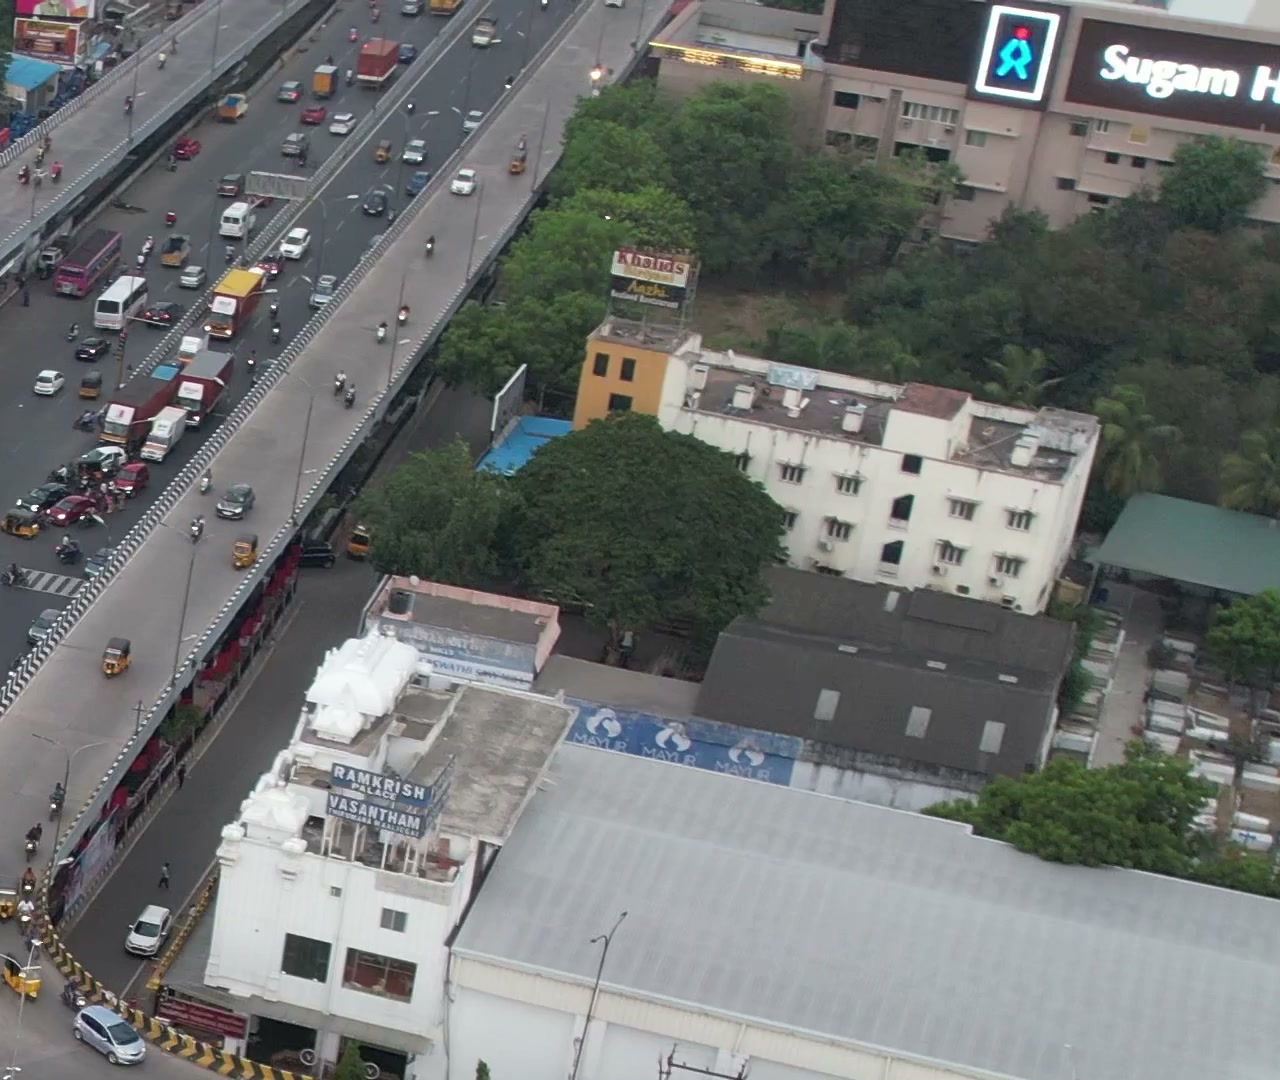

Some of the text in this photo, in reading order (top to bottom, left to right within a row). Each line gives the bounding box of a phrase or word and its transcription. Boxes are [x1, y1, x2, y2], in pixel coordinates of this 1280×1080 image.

[1100, 44, 1240, 99] Sugam
[572, 732, 628, 753] MAYUR
[642, 745, 697, 768] MAYUR
[333, 765, 426, 801] RAMKRISH
[715, 760, 771, 783] MAYUR
[351, 782, 397, 801] PALACE
[329, 795, 421, 831] VASANTHAM
